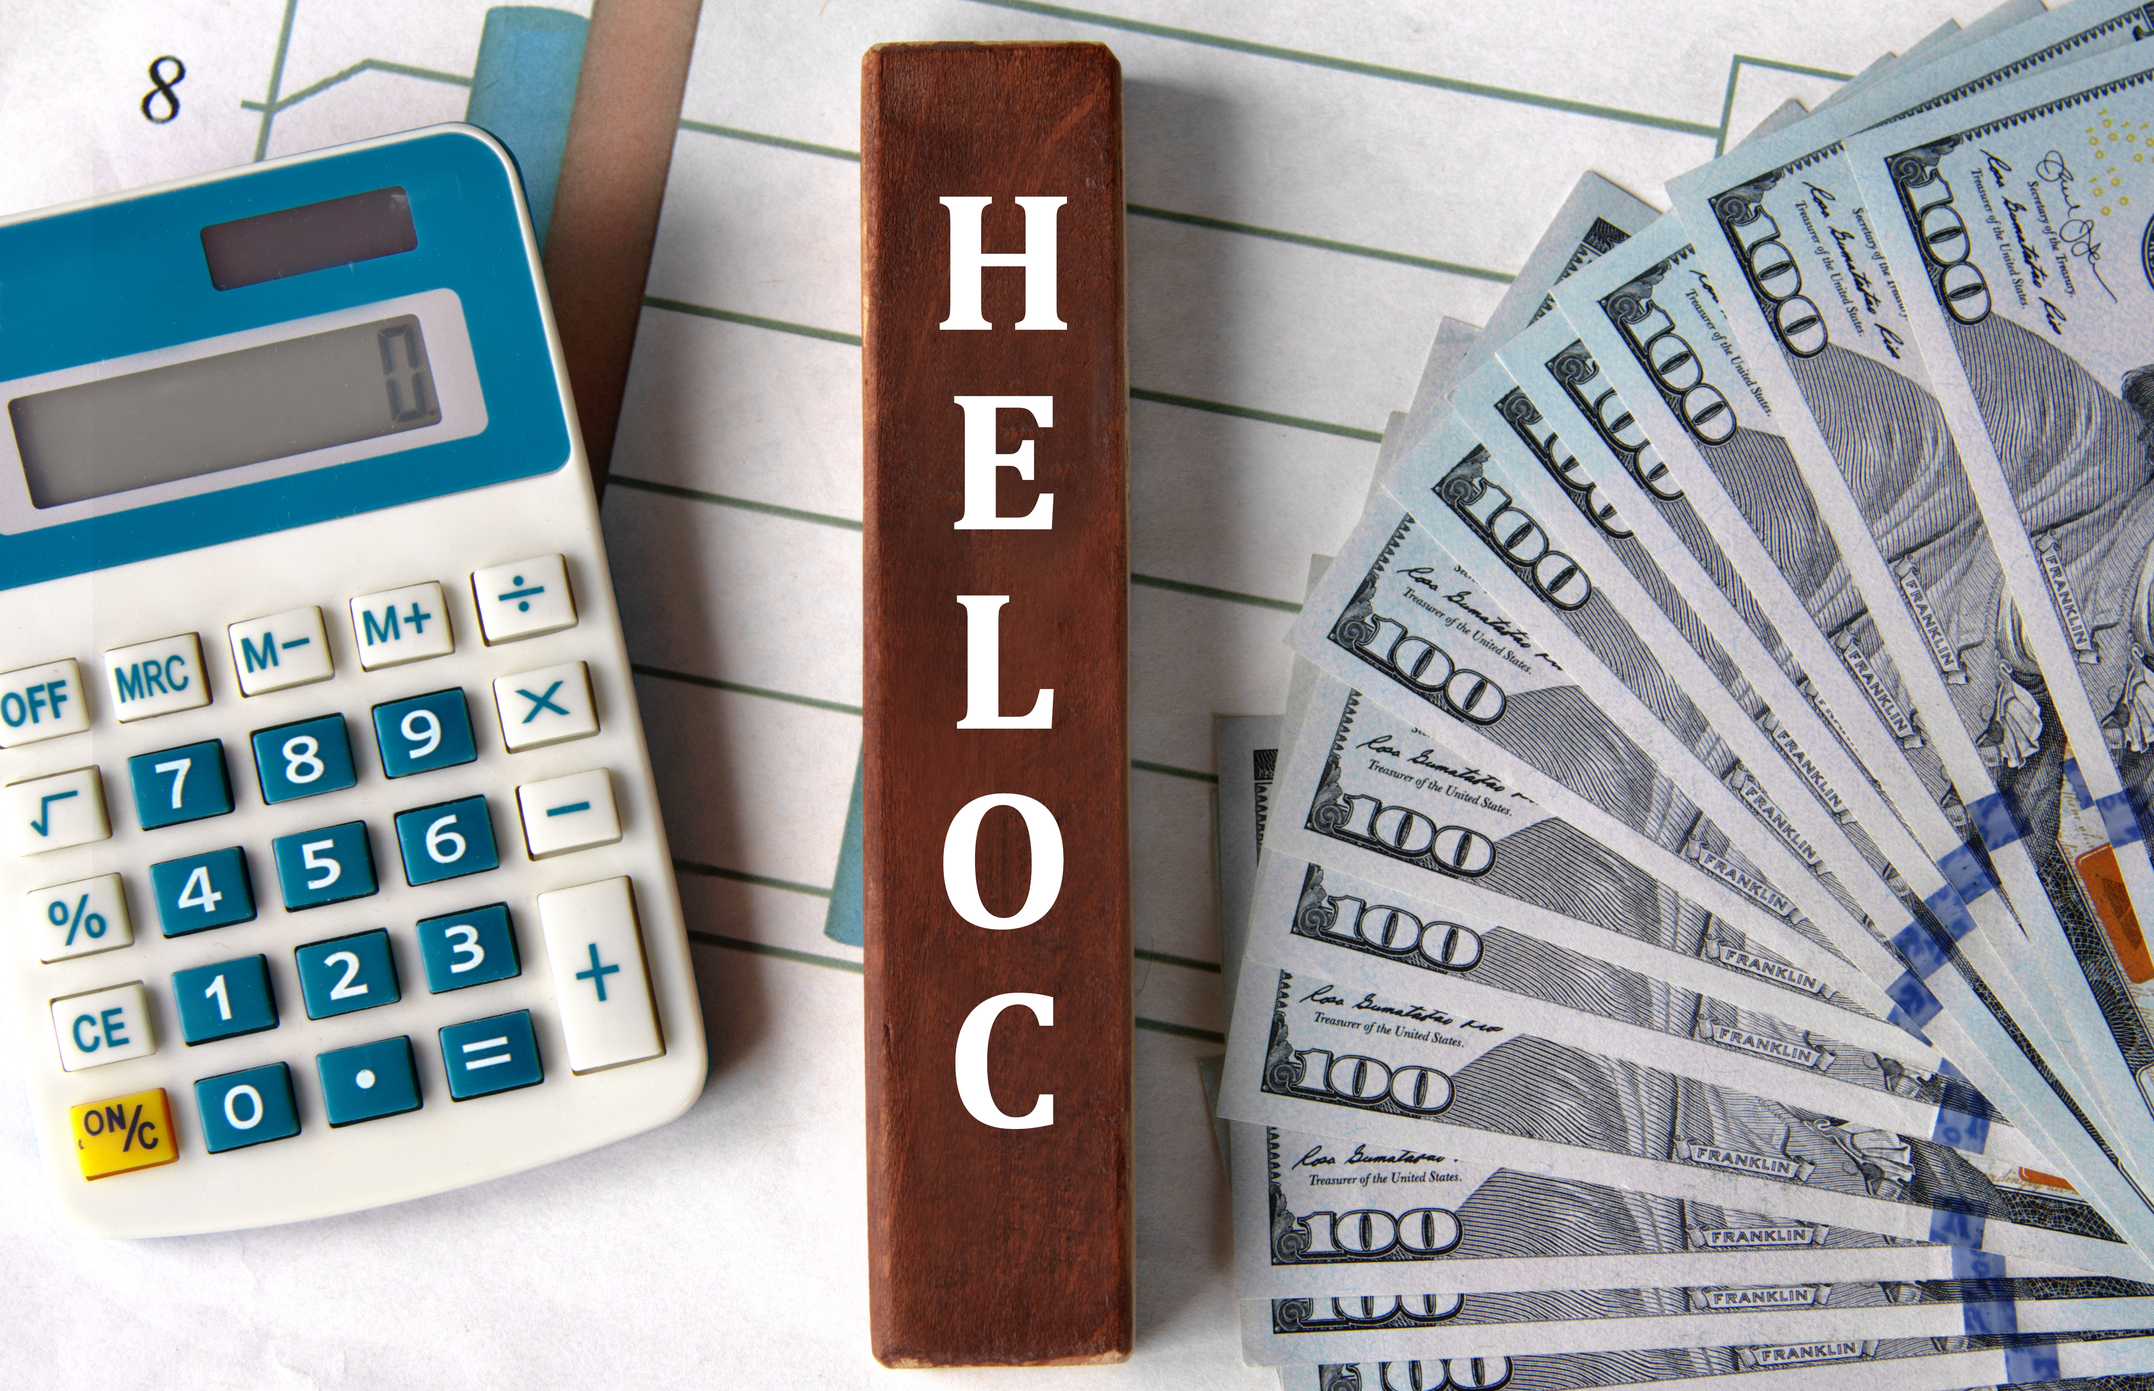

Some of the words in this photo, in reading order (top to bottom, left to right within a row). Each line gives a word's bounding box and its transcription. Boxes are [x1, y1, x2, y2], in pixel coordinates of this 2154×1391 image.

[140, 55, 187, 124] 8
[1971, 168, 1993, 212] Treasurer
[2027, 181, 2049, 223] Secretary
[1852, 207, 1877, 249] Secretary
[1871, 251, 1885, 260] of
[1986, 215, 2001, 225] of
[1993, 224, 2004, 240] the
[2042, 226, 2057, 235] of
[2049, 237, 2060, 251] the
[1795, 200, 1820, 243] Treasurer
[1814, 246, 1830, 255] of
[1822, 257, 1834, 271] the
[1830, 272, 1854, 305] United
[1846, 306, 1864, 337] States.
[1899, 167, 1992, 325] 100
[1999, 243, 2020, 276] United
[1724, 204, 1829, 359] 100
[2012, 278, 2028, 309] States.
[2055, 253, 2076, 298] Treasury.
[1618, 299, 1738, 447] 100
[1685, 288, 1716, 329] Treasurer
[1711, 332, 1727, 344] of
[1720, 342, 1733, 356] the
[1731, 355, 1757, 387] United
[1750, 387, 1772, 417] States.
[1456, 478, 1593, 612] 100
[362, 601, 431, 646] M+
[1906, 579, 1954, 666] FRANKLIN
[2046, 555, 2087, 644] FRANKLIN
[1403, 587, 1445, 618] Treasurer
[1445, 617, 1460, 627] of
[1456, 619, 1471, 635] the
[1472, 630, 1506, 655] United
[1502, 650, 1531, 674] States.
[114, 654, 190, 701] MRC
[939, 196, 1067, 1129] HELOC
[1354, 615, 1507, 728] 100
[0, 679, 69, 728] OFF
[1846, 650, 1911, 732] FRANKLIN
[281, 735, 324, 783] 8
[400, 710, 441, 759] 9
[155, 758, 192, 808] 7
[1368, 759, 1414, 782] Treasurer
[1415, 778, 1429, 789] of
[1427, 780, 1443, 792] the
[1446, 785, 1481, 805] United
[1480, 797, 1512, 816] States.
[1777, 730, 1842, 807] FRANKLIN
[425, 814, 467, 864] 6
[1333, 794, 1497, 878] 100
[1745, 783, 1816, 863] FRANKLIN
[302, 840, 342, 889] 5
[1704, 853, 1790, 911] FRANKLIN
[177, 867, 222, 913] 4
[48, 893, 107, 946] %
[1317, 895, 1485, 973] 100
[445, 924, 484, 973] 3
[1725, 947, 1816, 989] FRANKLIN
[205, 974, 234, 1021] 1
[323, 950, 368, 1000] 2
[72, 1007, 129, 1054] CE
[1314, 1011, 1362, 1029] Treasurer
[1364, 1022, 1377, 1035] of
[1376, 1023, 1392, 1035] the
[1395, 1025, 1431, 1041] United
[1431, 1032, 1464, 1047] States.
[1719, 1028, 1811, 1062] FRANKLIN
[224, 1083, 263, 1130] 0
[1287, 1048, 1456, 1116] 100
[84, 1104, 158, 1152] ON/C
[1309, 1174, 1357, 1186] Treasurer
[1359, 1173, 1372, 1187] of
[1373, 1173, 1388, 1184] the
[1391, 1172, 1426, 1183] United
[1429, 1171, 1462, 1182] States.
[1697, 1147, 1790, 1174] FRANKLIN
[1296, 1208, 1465, 1260] 100
[1712, 1230, 1805, 1243] FRANKLIN
[1713, 1289, 1808, 1304] FRANKLIN
[1761, 1342, 1856, 1361] FRANKLIN
